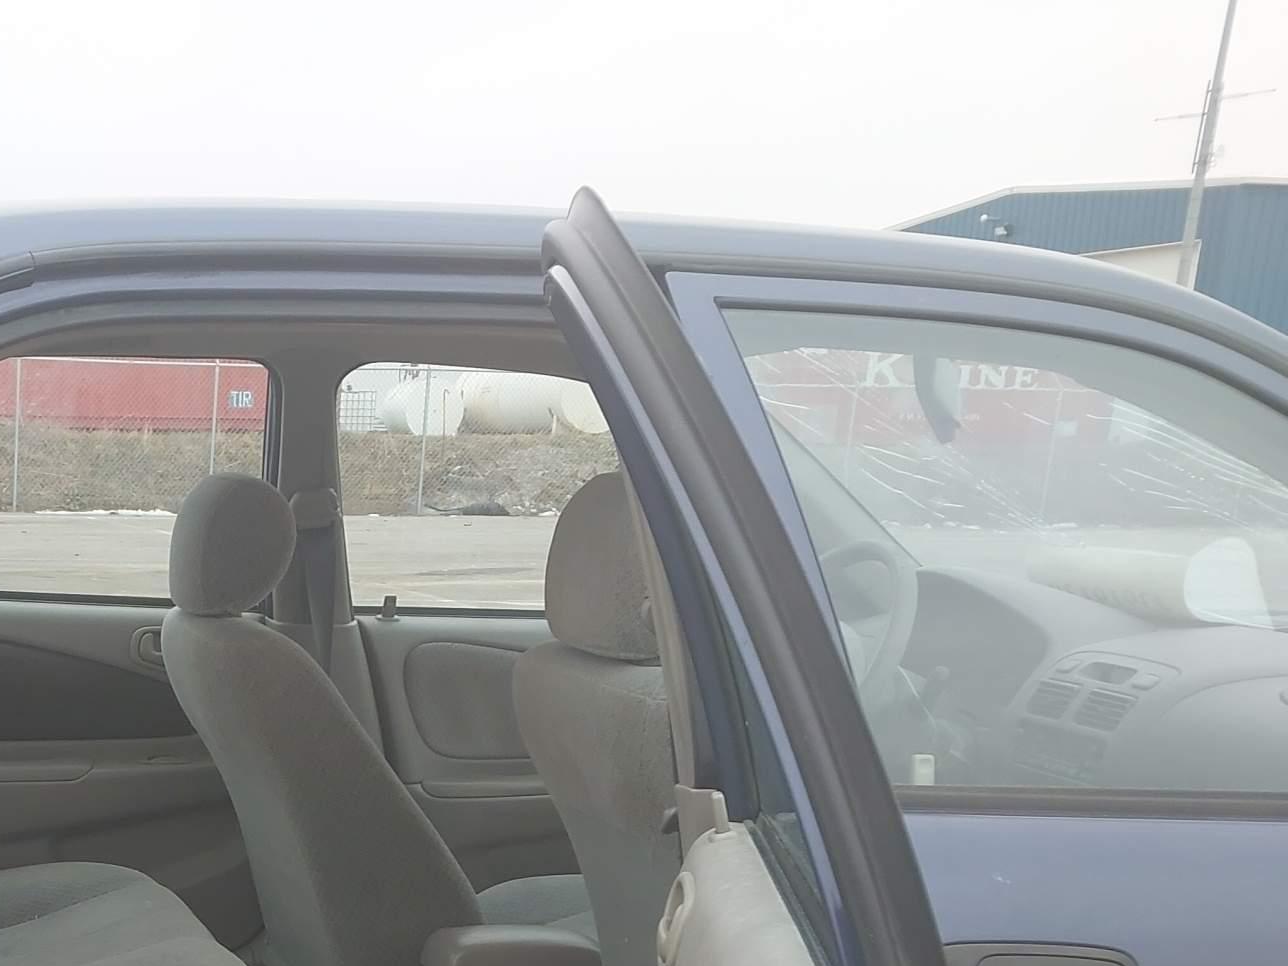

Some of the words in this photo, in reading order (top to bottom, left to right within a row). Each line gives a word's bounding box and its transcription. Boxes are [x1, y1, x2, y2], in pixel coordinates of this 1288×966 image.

[859, 352, 904, 387] K
[948, 364, 1039, 389] INE
[230, 390, 253, 408] TIR
